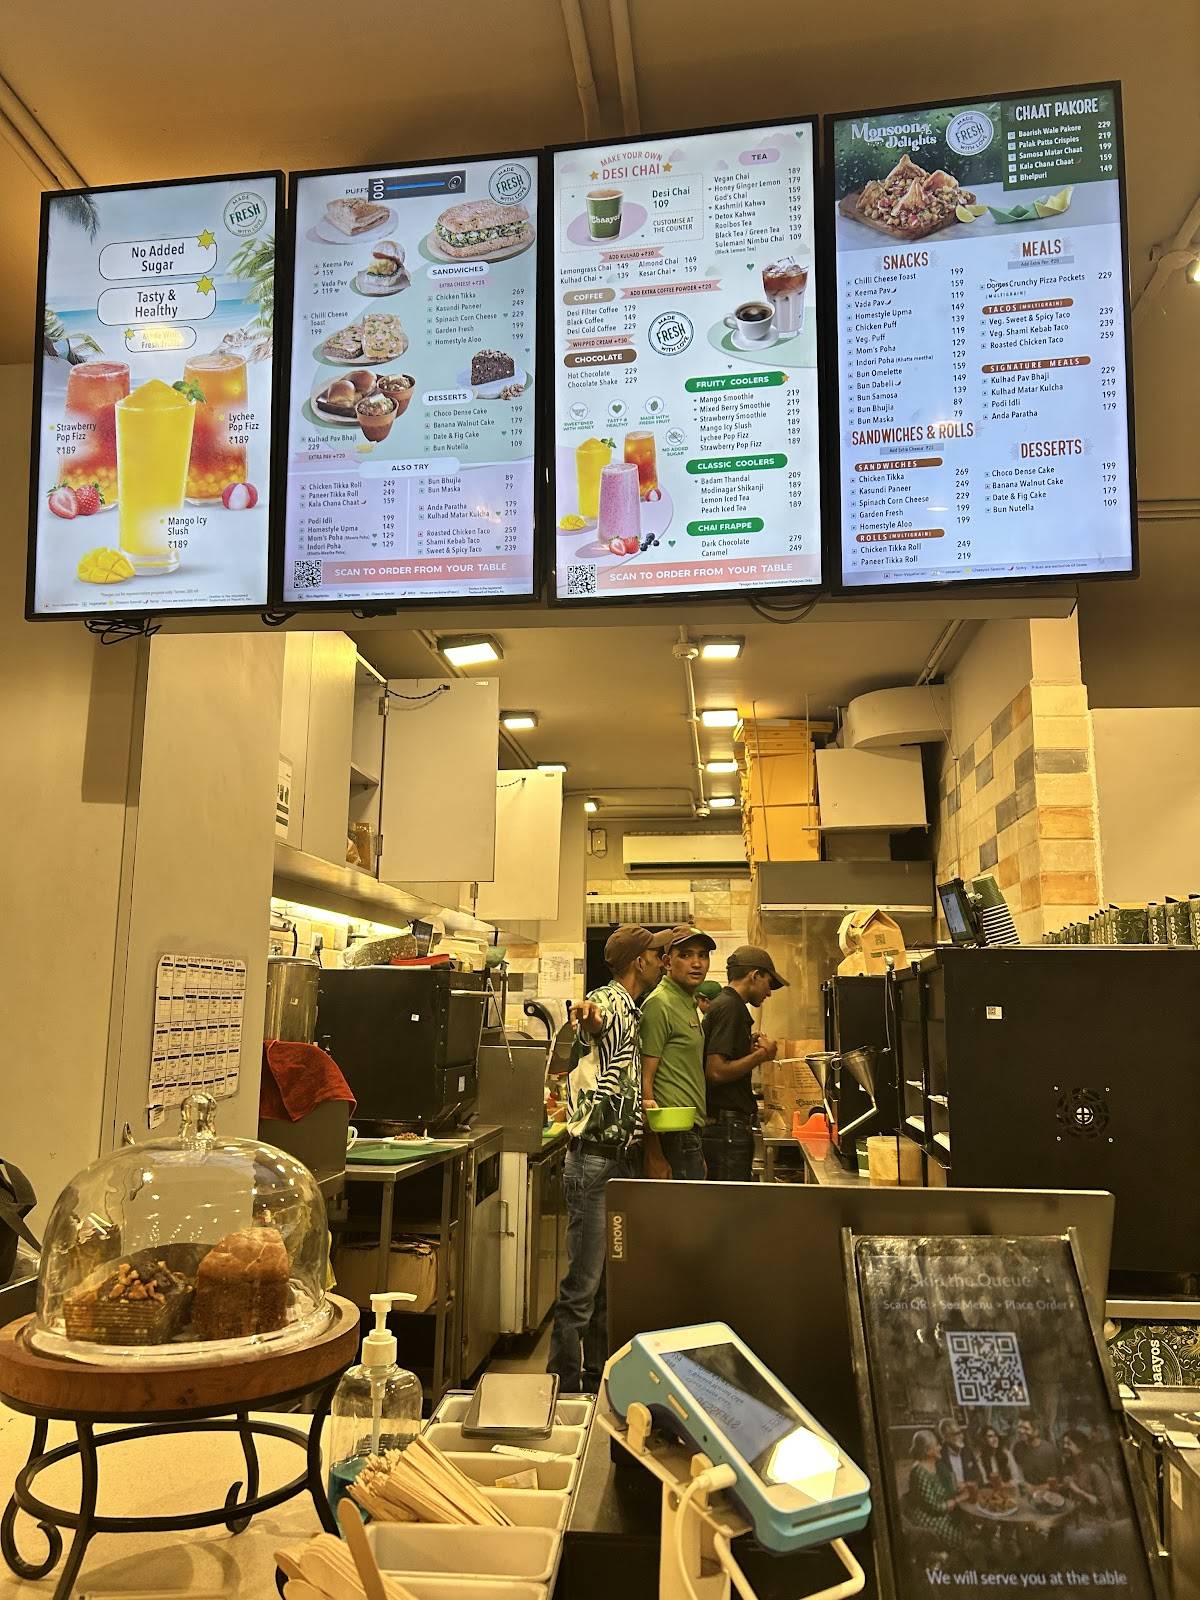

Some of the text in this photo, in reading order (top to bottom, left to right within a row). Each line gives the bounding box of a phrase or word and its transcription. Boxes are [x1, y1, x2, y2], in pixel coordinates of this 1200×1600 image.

[1016, 98, 1098, 121] CHAAT PAKORE
[851, 122, 932, 141] Monsoon
[955, 123, 984, 142] FRESH
[1018, 128, 1040, 139] Baarish
[1043, 126, 1057, 136] Wale
[1059, 124, 1081, 134] Pakore
[886, 135, 936, 151] Delights
[1019, 140, 1034, 148] Palak
[1036, 138, 1052, 147] Patta
[1098, 132, 1111, 140] 219
[601, 152, 663, 167] MAKE YOUR OWN
[752, 153, 767, 161] TEA
[1020, 150, 1040, 160] Samosa
[1042, 148, 1058, 158] Matar
[1062, 146, 1082, 156] Chaat
[1020, 162, 1034, 170] Kala
[1036, 160, 1054, 169] Chana
[1056, 158, 1074, 166] Chaat
[602, 164, 660, 180] DESI CHAI
[1020, 164, 1112, 183] Bhelpuri 149
[496, 174, 524, 194] FRESH
[714, 175, 734, 184] Vegan
[715, 184, 734, 193] Honey
[737, 181, 758, 190] Ginger
[759, 178, 781, 187] Lemon
[373, 180, 384, 199] 100
[652, 187, 690, 198] Desi Chai
[654, 200, 669, 208] 109
[229, 203, 261, 225] FRESH
[653, 218, 684, 227] CUSTOMISE
[667, 223, 693, 232] COUNTER
[131, 243, 185, 258] No Added
[1022, 239, 1062, 257] MEALS
[142, 259, 174, 274] Sugar
[883, 252, 928, 270] SNACKS
[432, 265, 484, 276] SANDWICHES
[1009, 272, 1112, 289] Crunchy Pizza Pockets 229
[137, 289, 176, 304] Tasty &
[436, 293, 459, 301] Chicken
[512, 288, 524, 296] 269
[573, 292, 603, 301] COFFEE
[135, 304, 178, 320] Healthy
[586, 316, 604, 324] Coffee
[624, 313, 636, 321] 149
[855, 314, 965, 332] Chicken Puff 139
[656, 323, 686, 344] FRESH
[575, 353, 622, 364] CHOCOLATE
[990, 357, 1080, 372] SIGNATURE MEALS
[696, 375, 769, 388] FRUITY COOLERS
[428, 394, 467, 402] DESSERTS
[700, 395, 722, 405] Mango
[724, 392, 754, 402] Smoothie
[228, 413, 255, 422] Lychee
[56, 422, 96, 432] Strawberry
[228, 422, 259, 432] Pop Fizz
[852, 422, 974, 445] SANDWICHES & ROLLS
[56, 432, 86, 442] Pop Fizz
[229, 435, 249, 444] ₹189
[56, 446, 76, 455] ₹189
[1021, 439, 1082, 459] DESSERTS
[697, 458, 775, 471] CLASSIC COOLERS
[859, 460, 917, 470] SANDWICHES
[992, 462, 1116, 478] Choco Dense Cake 199
[859, 467, 969, 483] Chicken Tikka 269
[701, 495, 723, 504] Lemon
[993, 498, 1117, 513] Bun Nutella 109
[168, 516, 207, 527] Mango Icy
[698, 520, 752, 532] CHAI FRAPPE
[168, 527, 189, 535] Slush
[168, 540, 188, 549] ₹189
[702, 534, 802, 548] Dark Chocolate 279
[701, 544, 802, 557] Caramel 249
[335, 563, 507, 577] SCAN TO ORDER FROM YOUR TABLE
[610, 563, 793, 581] SCAN TO ORDER FROM YOUR TABLE
[612, 1216, 622, 1258] Lenovo
[977, 1274, 1032, 1289] Queue
[911, 1301, 927, 1310] QR
[1005, 1301, 1067, 1310] Place Order
[926, 1568, 1127, 1587] We will serve you at the table
